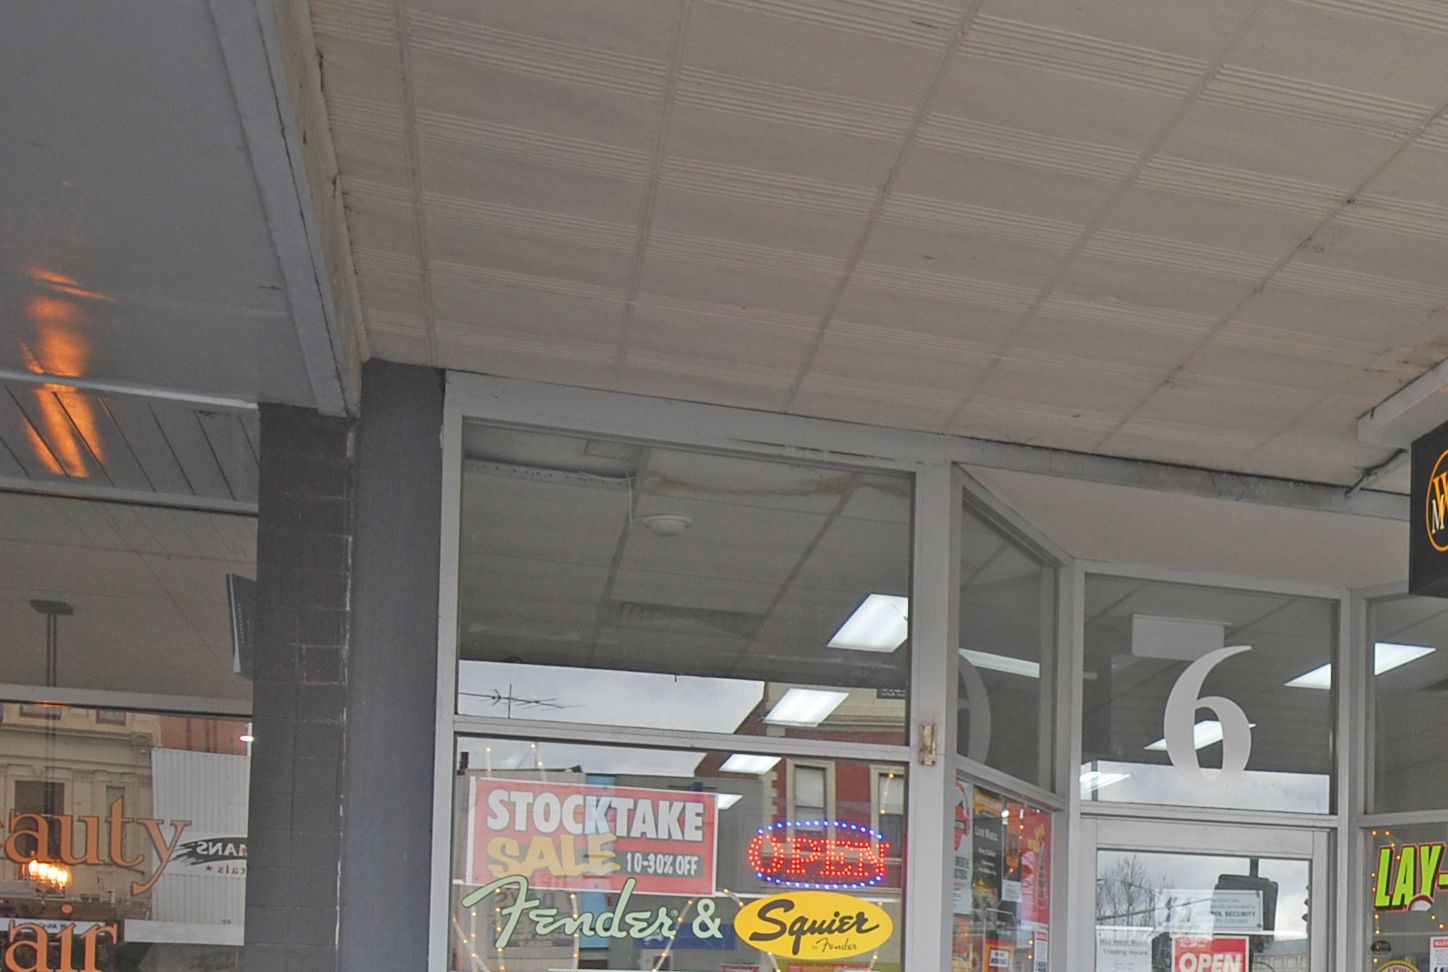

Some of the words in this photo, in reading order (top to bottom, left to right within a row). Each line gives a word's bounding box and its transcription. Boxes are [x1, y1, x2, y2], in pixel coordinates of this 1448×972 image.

[1164, 645, 1252, 789] 6
[487, 789, 704, 841] STOCKTAKE
[0, 795, 192, 896] auty
[487, 834, 620, 878] SALE
[626, 853, 673, 875] 10-30%
[675, 856, 698, 876] OFF
[748, 834, 890, 878] OPEN
[462, 876, 678, 949] Fender
[692, 899, 723, 938] &
[749, 898, 879, 955] Squier
